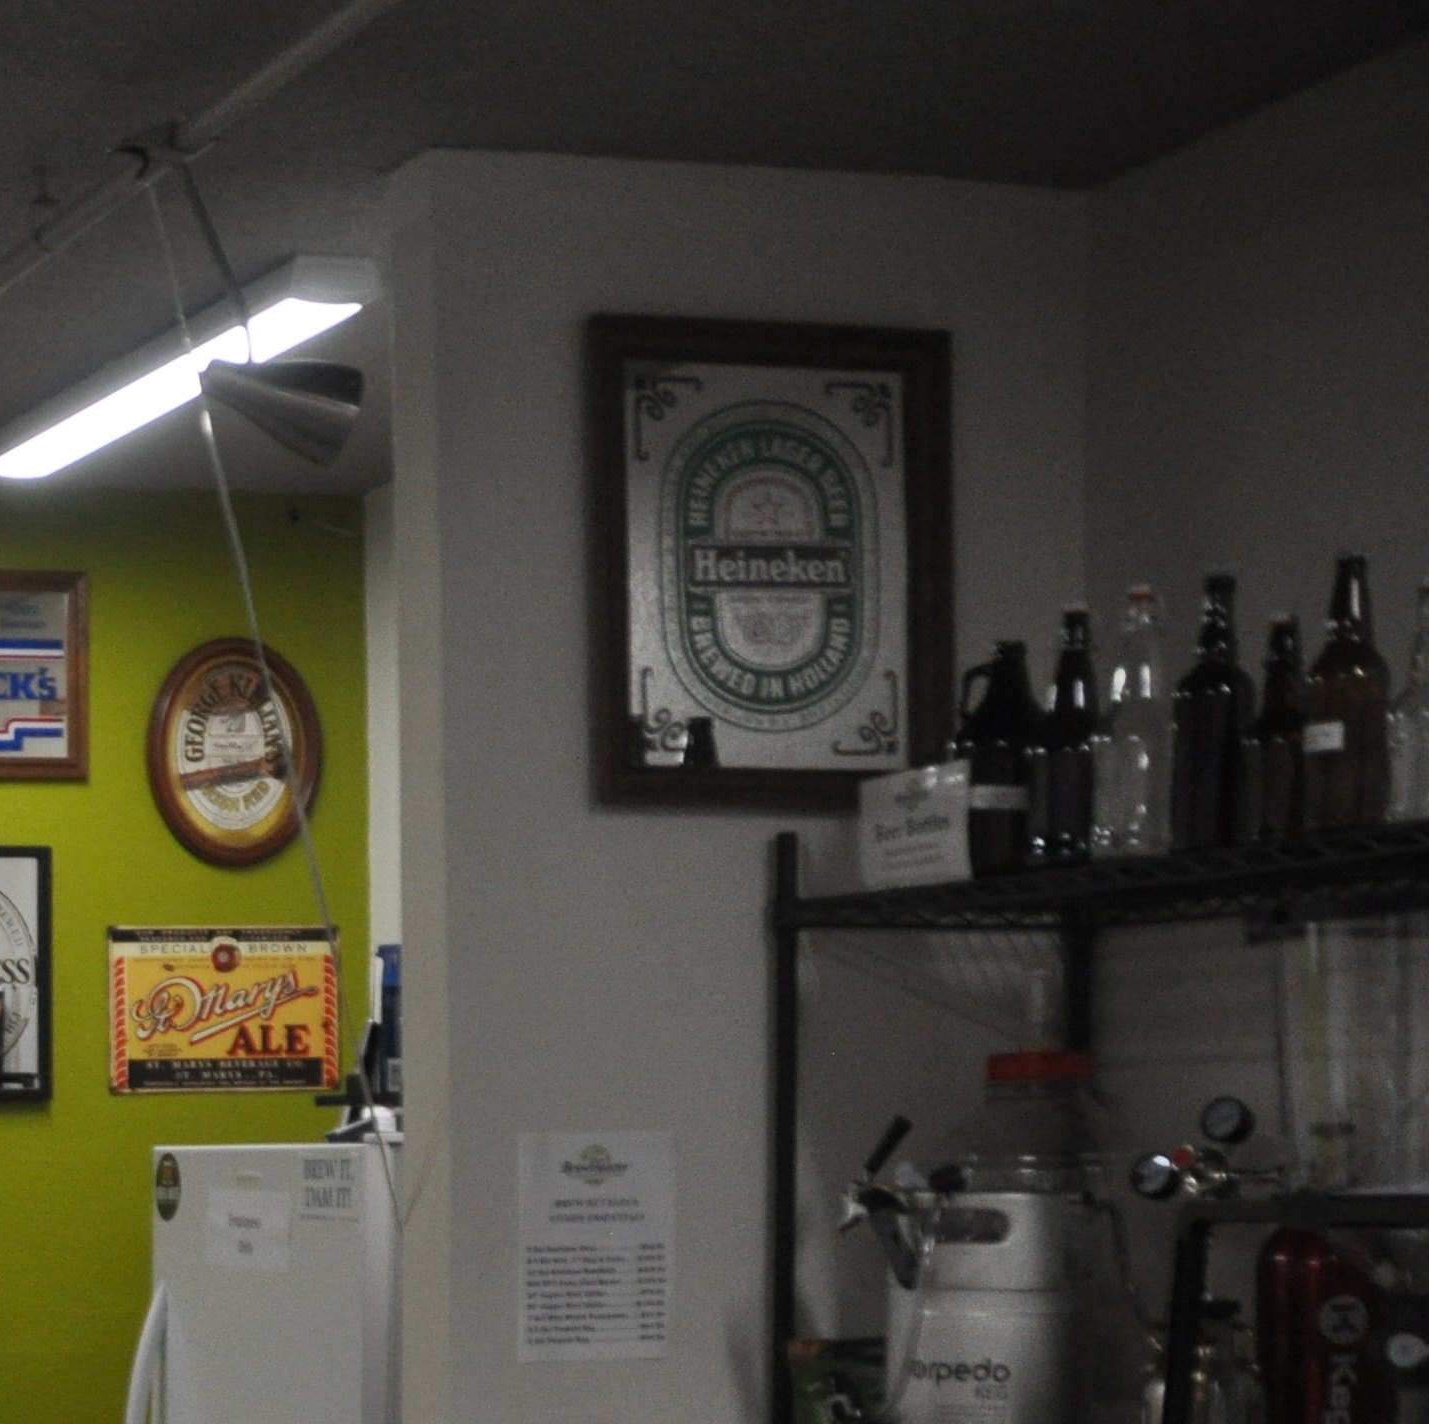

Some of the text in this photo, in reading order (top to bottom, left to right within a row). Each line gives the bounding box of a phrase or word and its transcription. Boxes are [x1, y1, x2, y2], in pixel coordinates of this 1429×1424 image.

[693, 550, 846, 583] Heineken
[184, 676, 230, 763] GEORGE
[141, 942, 308, 955] SPECIAL BROWN
[228, 1022, 312, 1057] ALE
[909, 1358, 1012, 1387] orpedo
